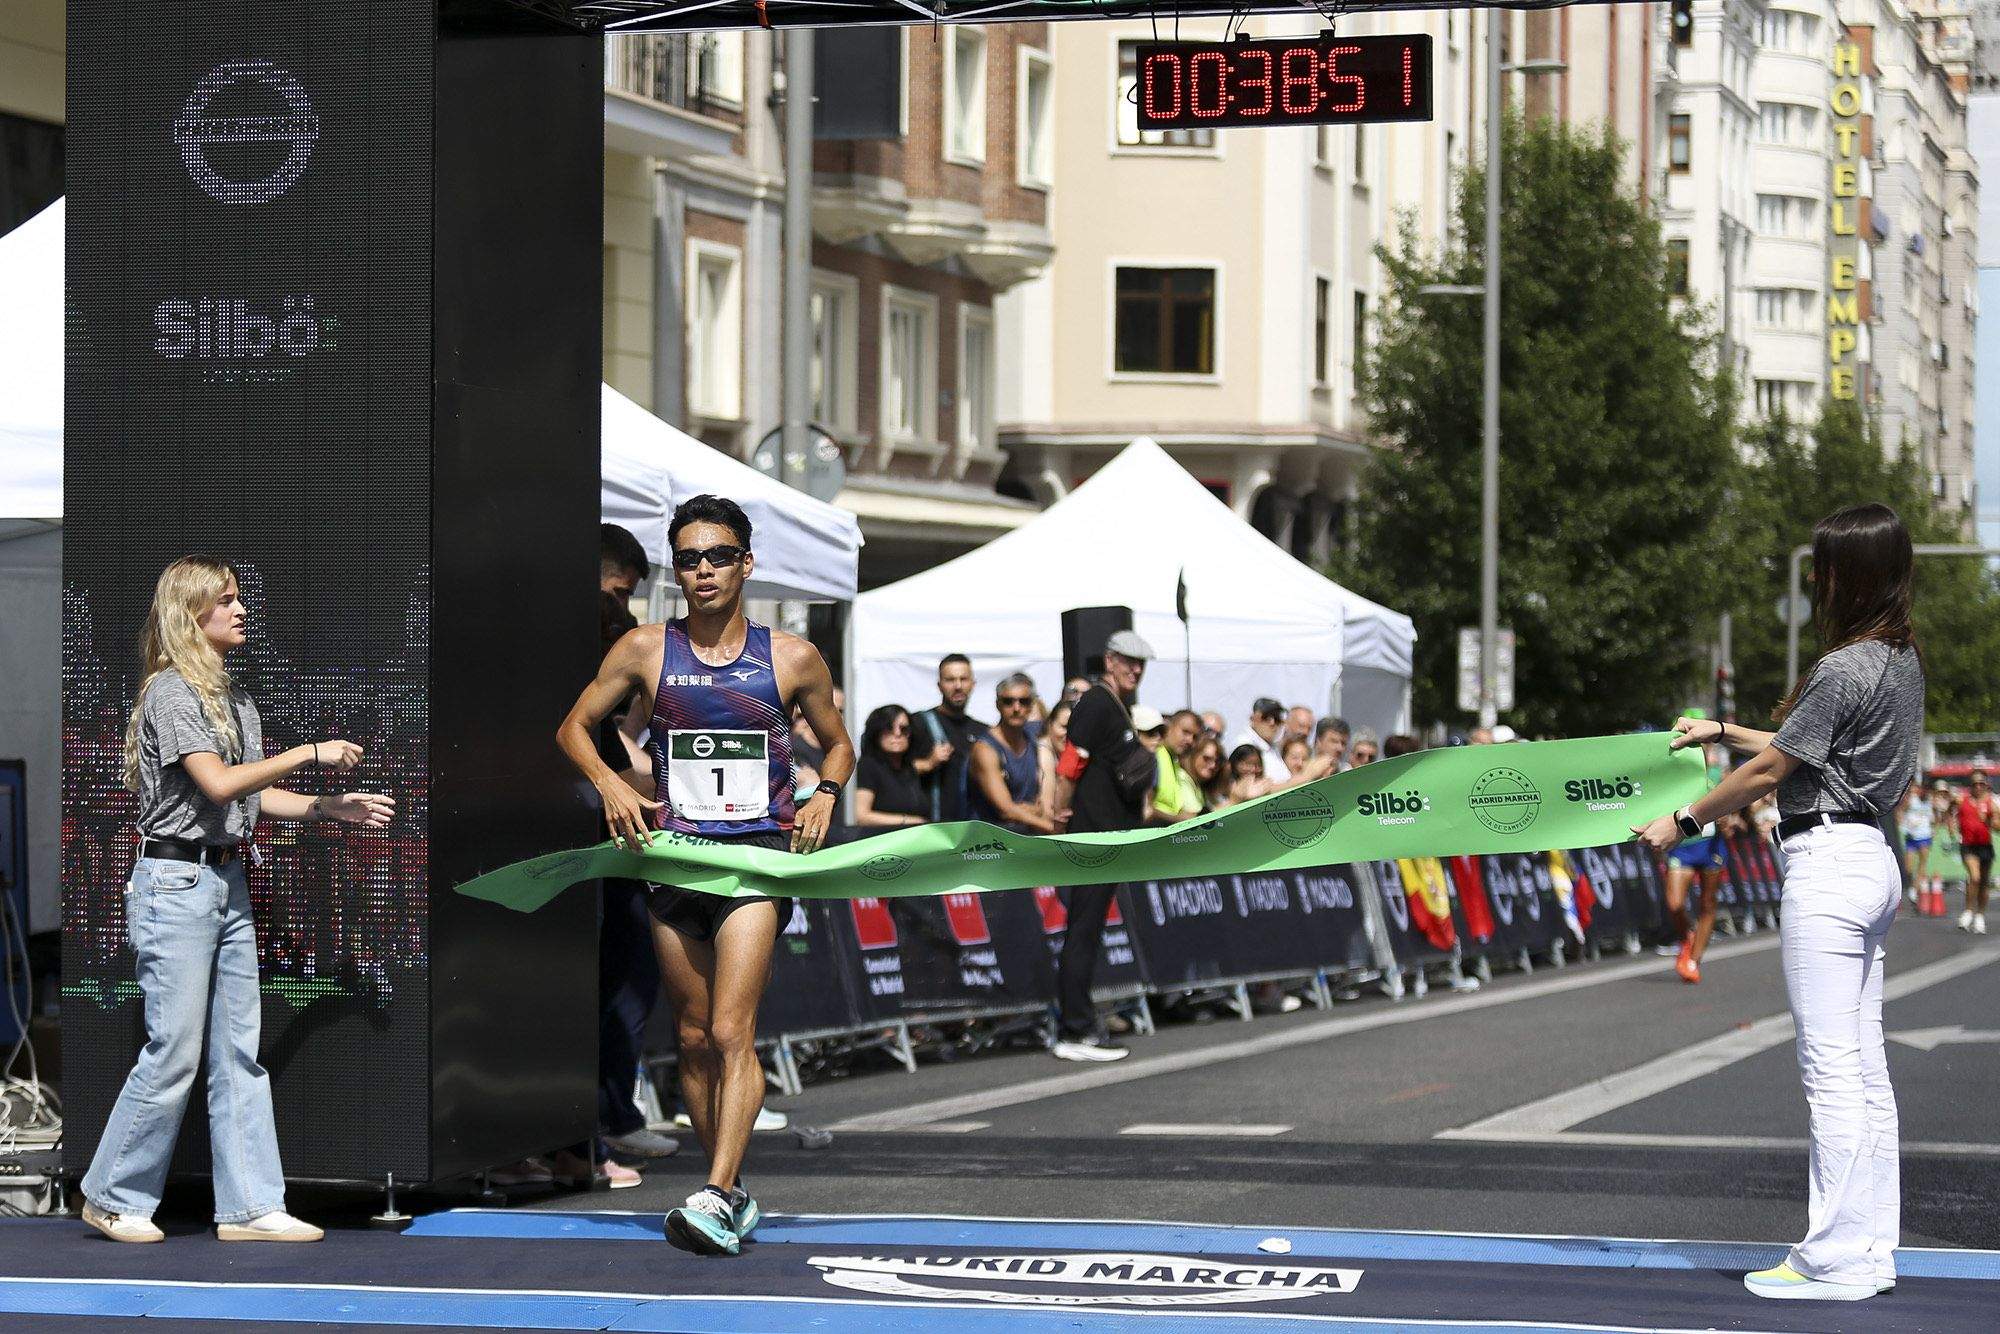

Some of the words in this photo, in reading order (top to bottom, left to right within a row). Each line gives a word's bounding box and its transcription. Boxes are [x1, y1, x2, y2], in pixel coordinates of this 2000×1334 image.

[1830, 42, 1861, 236] HOTEL
[711, 768, 724, 796] 1
[1563, 776, 1634, 801] Silbö
[1357, 790, 1423, 816] Silbö
[1471, 796, 1503, 805] MADRID
[1504, 794, 1539, 802] MARCHA
[1586, 801, 1626, 812] Telecom
[1265, 811, 1297, 820] MADRID
[1298, 808, 1332, 817] MARCHA
[1377, 815, 1415, 826] Telecom
[1171, 833, 1208, 844] Telecom
[961, 852, 1001, 861] Telecom
[1082, 1262, 1342, 1289] MARCHA
